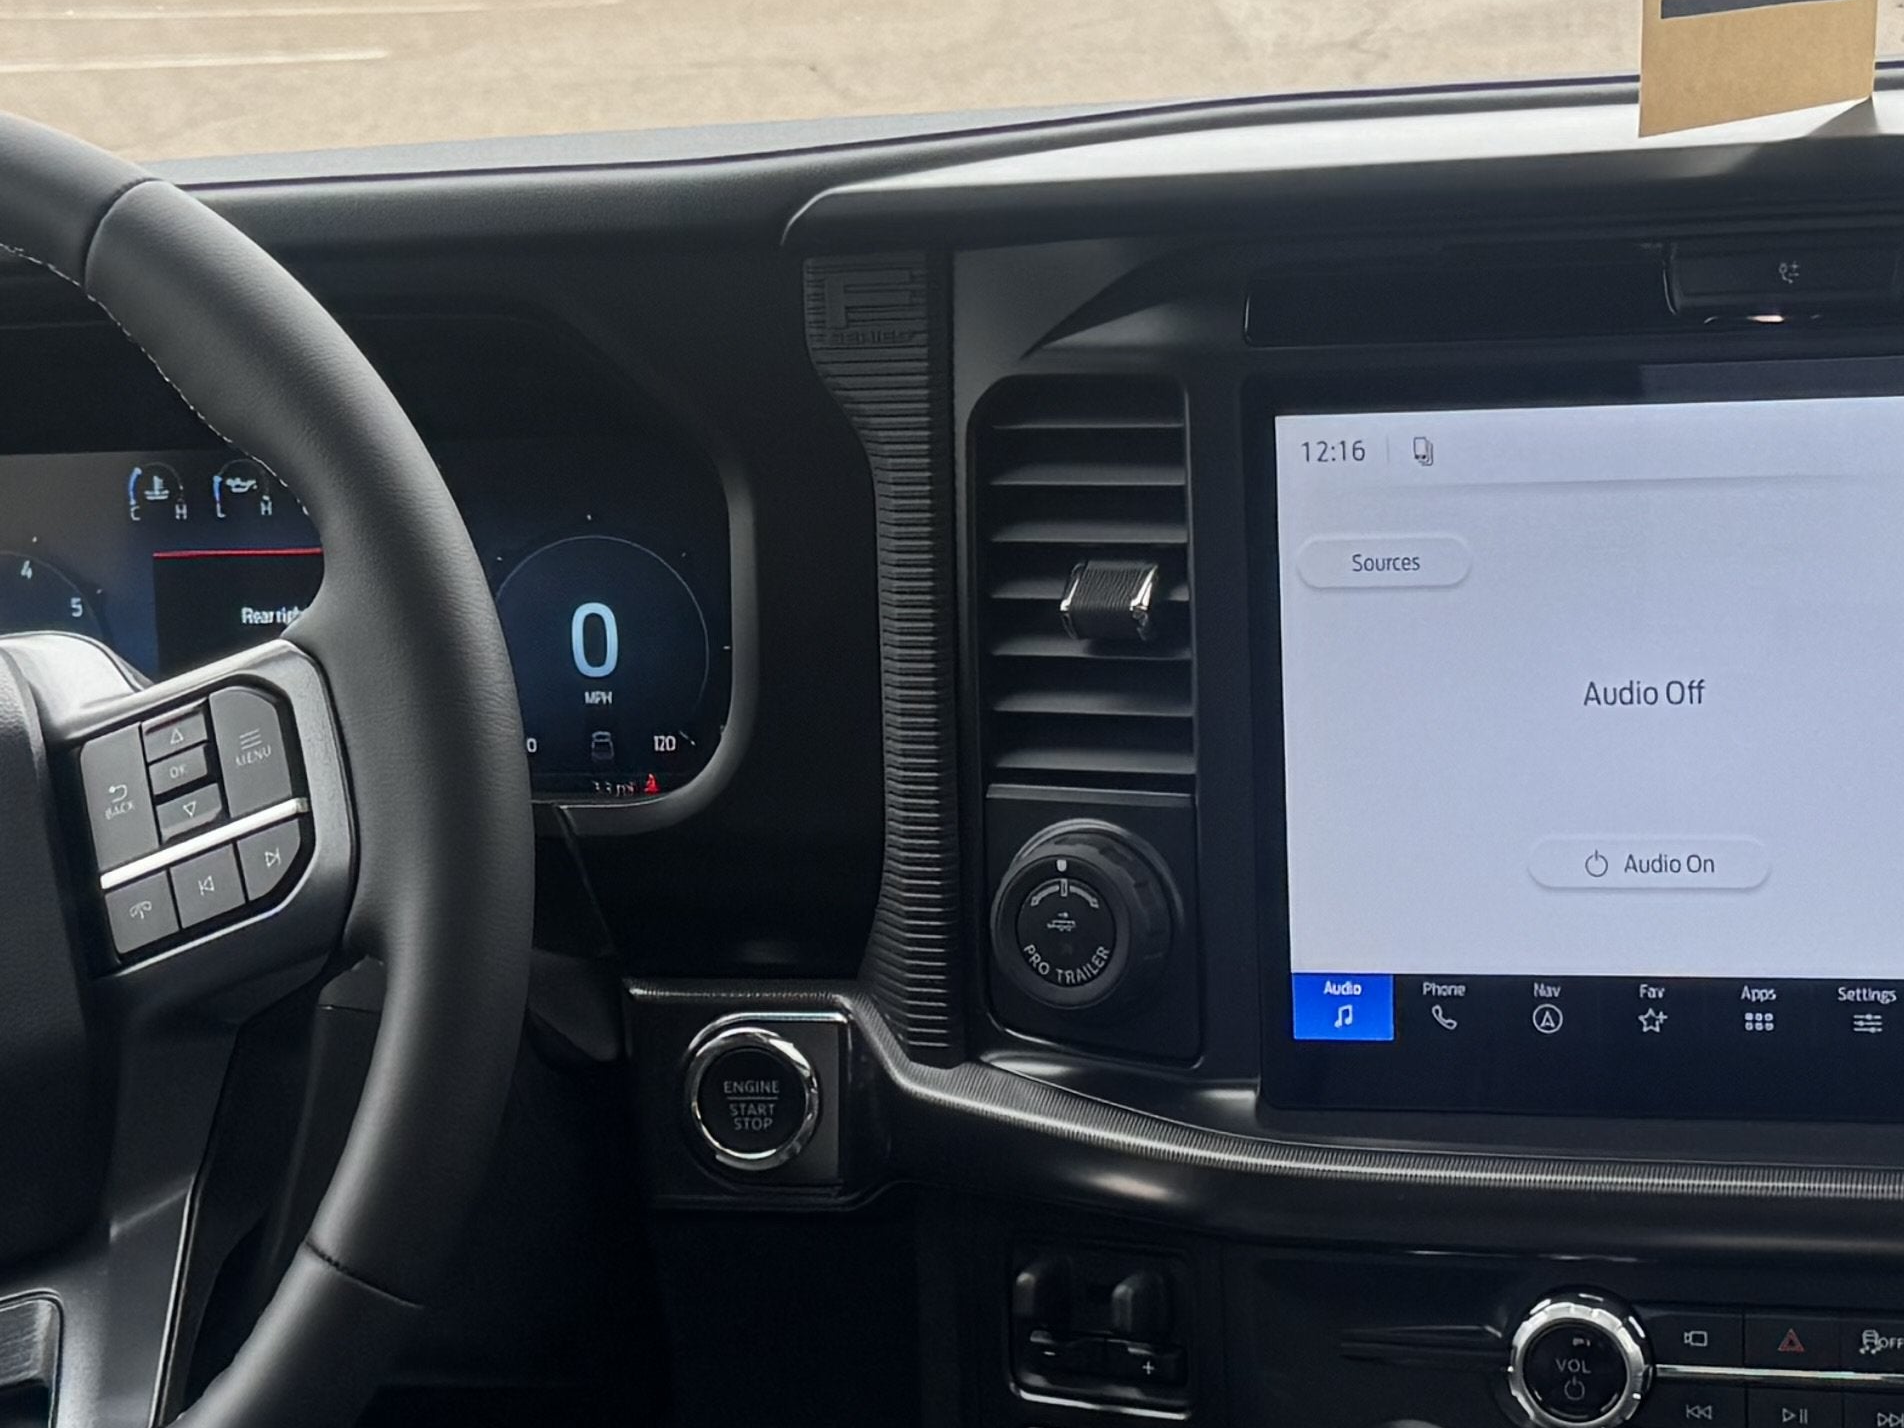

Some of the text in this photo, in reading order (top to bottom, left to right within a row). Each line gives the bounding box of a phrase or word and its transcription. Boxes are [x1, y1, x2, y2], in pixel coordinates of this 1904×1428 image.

[1300, 439, 1366, 465] 12:16
[21, 560, 32, 579] 4
[1351, 553, 1421, 573] Sources
[71, 599, 83, 617] 5
[241, 607, 273, 624] Rear
[571, 602, 618, 678] 0
[585, 691, 612, 704] MPH
[1583, 678, 1706, 706] Audio Off
[653, 735, 676, 752] 120
[235, 745, 272, 766] MENU
[105, 801, 135, 820] BACK
[1624, 852, 1716, 875] Audio On
[1023, 944, 1110, 984] PRO TRAILER
[1324, 982, 1361, 996] Audio
[1423, 983, 1466, 997] Phone
[1534, 984, 1561, 998] Nav
[1639, 985, 1665, 998] Fav
[1741, 986, 1776, 1003] Apps
[1838, 987, 1897, 1005] Settings
[723, 1080, 780, 1094] ENGINE
[729, 1103, 776, 1116] START
[734, 1117, 773, 1131] STOP
[1879, 1336, 1904, 1350] OFF
[1555, 1358, 1592, 1374] VOL
